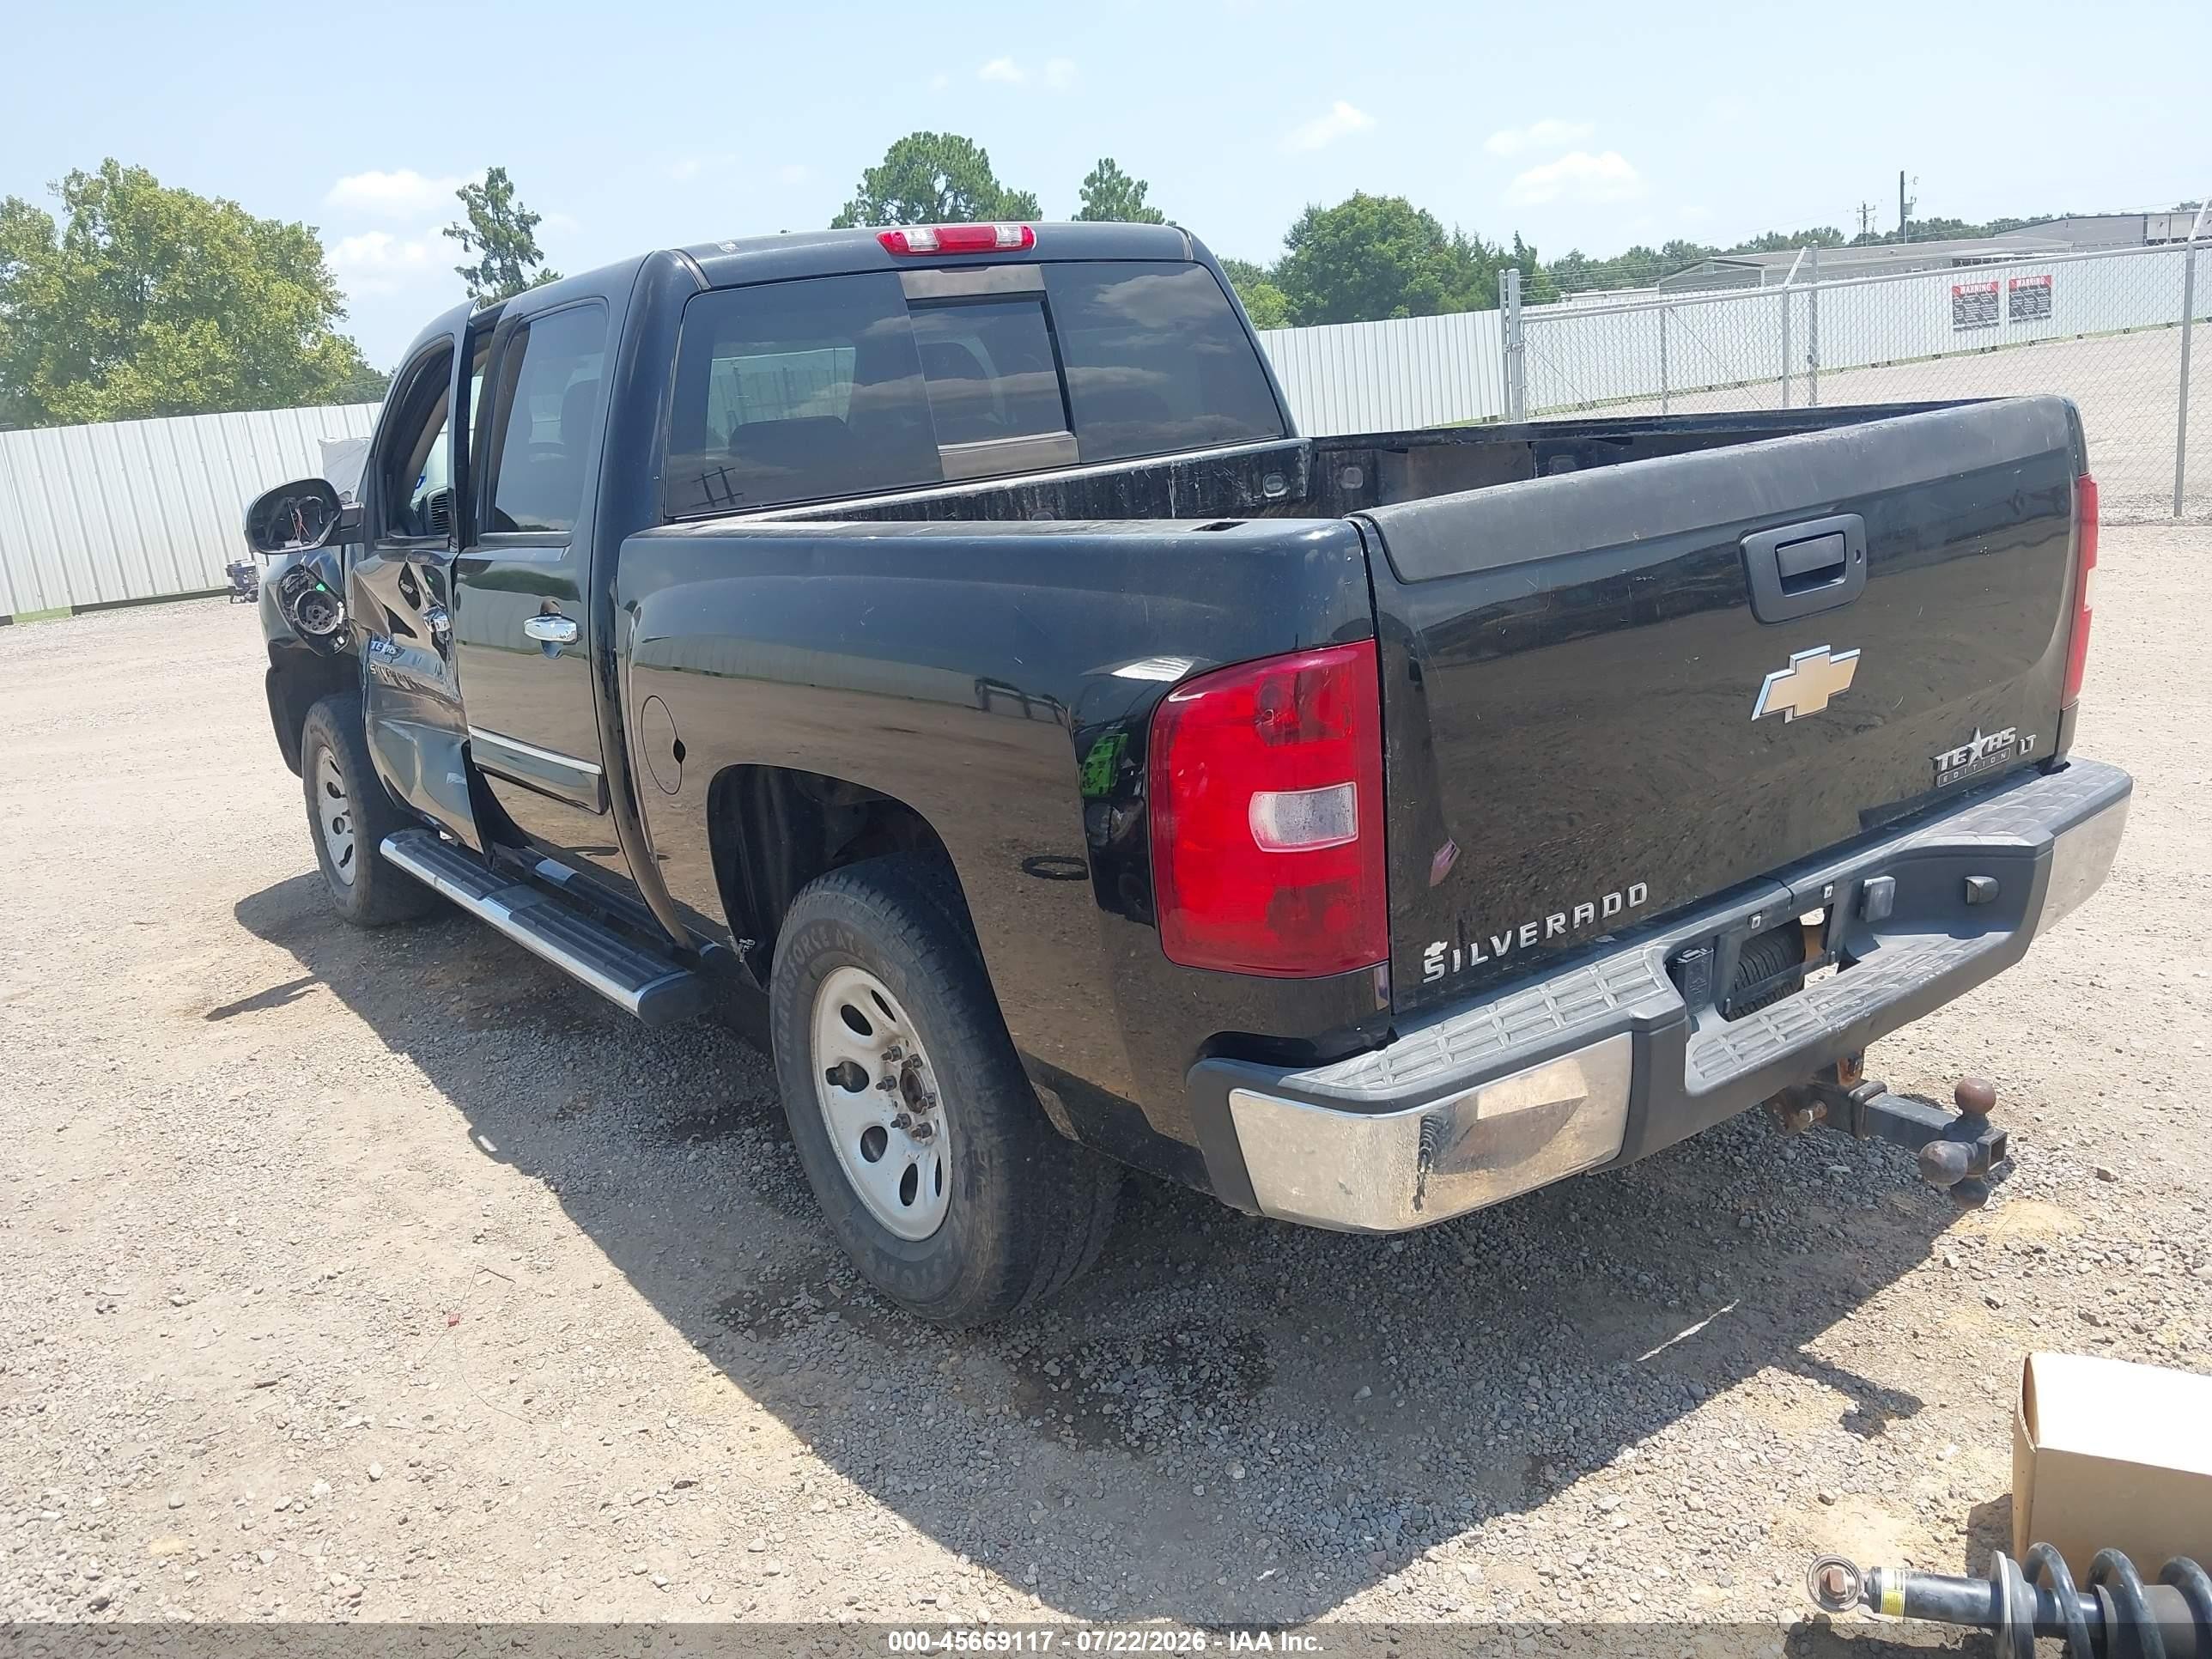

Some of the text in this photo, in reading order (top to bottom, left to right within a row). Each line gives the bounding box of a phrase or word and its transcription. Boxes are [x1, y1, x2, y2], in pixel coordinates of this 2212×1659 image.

[1960, 283, 1991, 295] WARNING
[2015, 276, 2045, 289] WARNING
[1934, 726, 2016, 771] TEXAS
[2020, 734, 2037, 756] LT
[1942, 751, 2007, 783] EDITION
[1422, 882, 1648, 984] SILVERADO
